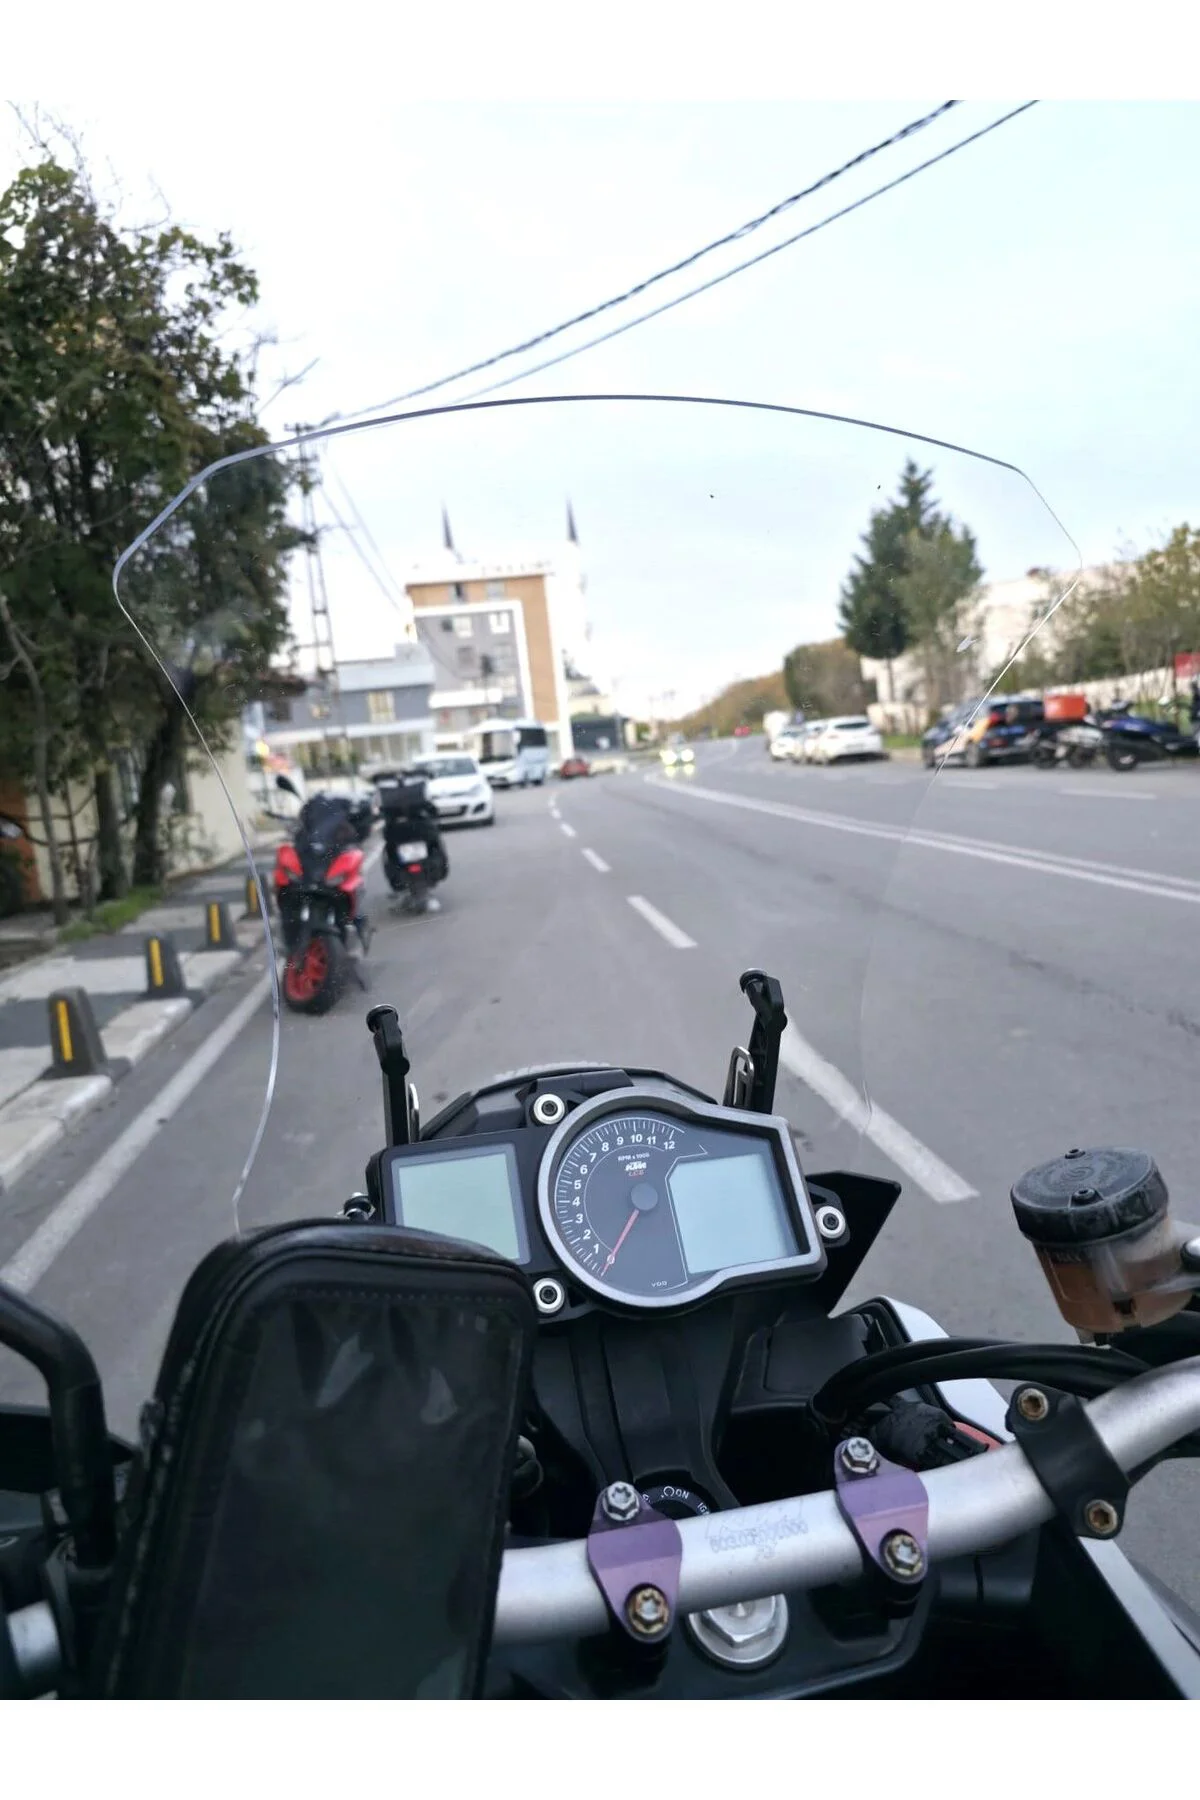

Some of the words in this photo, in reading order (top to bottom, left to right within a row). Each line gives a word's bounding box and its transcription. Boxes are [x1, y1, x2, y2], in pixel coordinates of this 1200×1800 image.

[616, 1136, 624, 1145] 9
[630, 1134, 643, 1143] 10
[647, 1136, 657, 1145] 11
[601, 1142, 610, 1151] 8
[664, 1140, 676, 1150] 12
[590, 1153, 597, 1163] 7
[580, 1165, 588, 1174] 6
[625, 1161, 647, 1171] KTM
[574, 1180, 582, 1189] 5
[572, 1197, 581, 1206] 4
[575, 1213, 584, 1223] 3
[583, 1229, 591, 1240] 2
[593, 1244, 600, 1254] 1
[651, 1280, 668, 1288] VDO
[675, 1488, 690, 1500] ON
